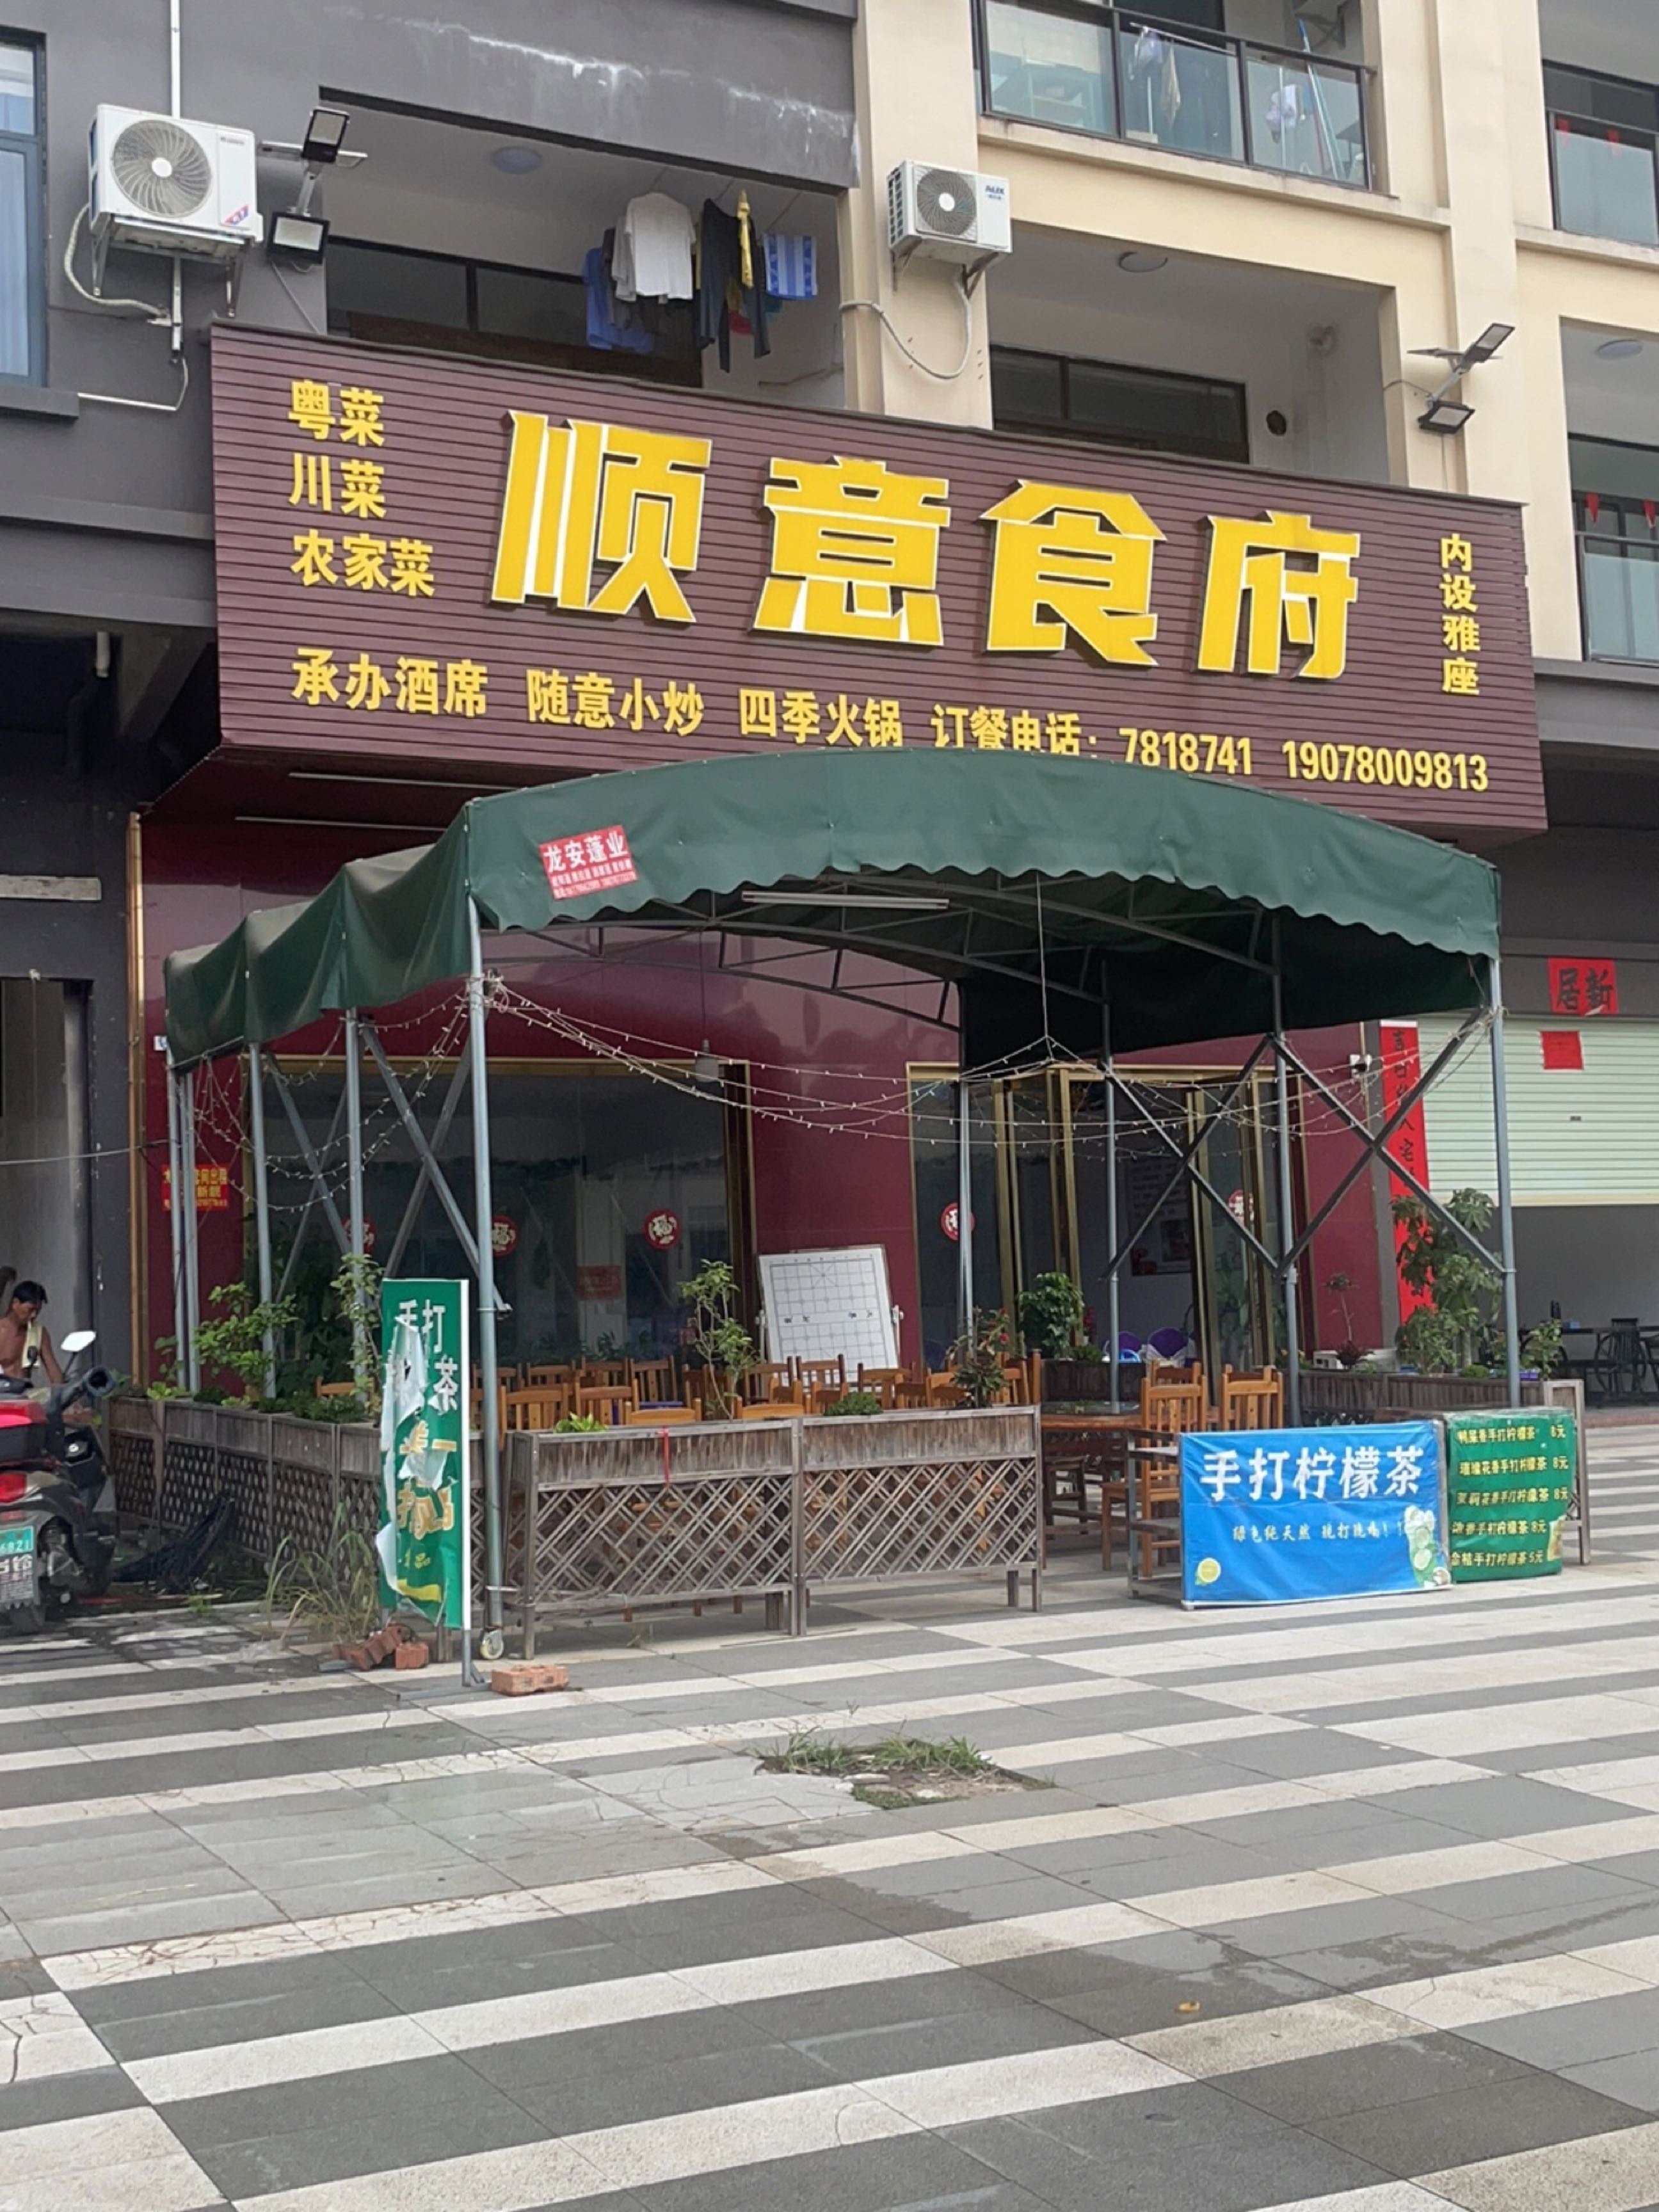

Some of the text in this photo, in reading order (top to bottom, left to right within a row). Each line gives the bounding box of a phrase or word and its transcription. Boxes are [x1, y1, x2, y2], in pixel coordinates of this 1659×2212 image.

[288, 380, 385, 446] 粤菜
[289, 454, 387, 518] 川菜
[290, 529, 435, 597] 农家菜
[490, 410, 1359, 678] 顺意食府
[1440, 533, 1480, 696] 内设雅座
[291, 648, 488, 717] 承办酒席
[526, 669, 705, 737] 随意小炒
[739, 688, 903, 747] 四季火锅
[1119, 728, 1252, 774] 7818741
[1283, 741, 1488, 792] 19078009813
[1200, 1445, 1424, 1502] 手打柠檬茶
